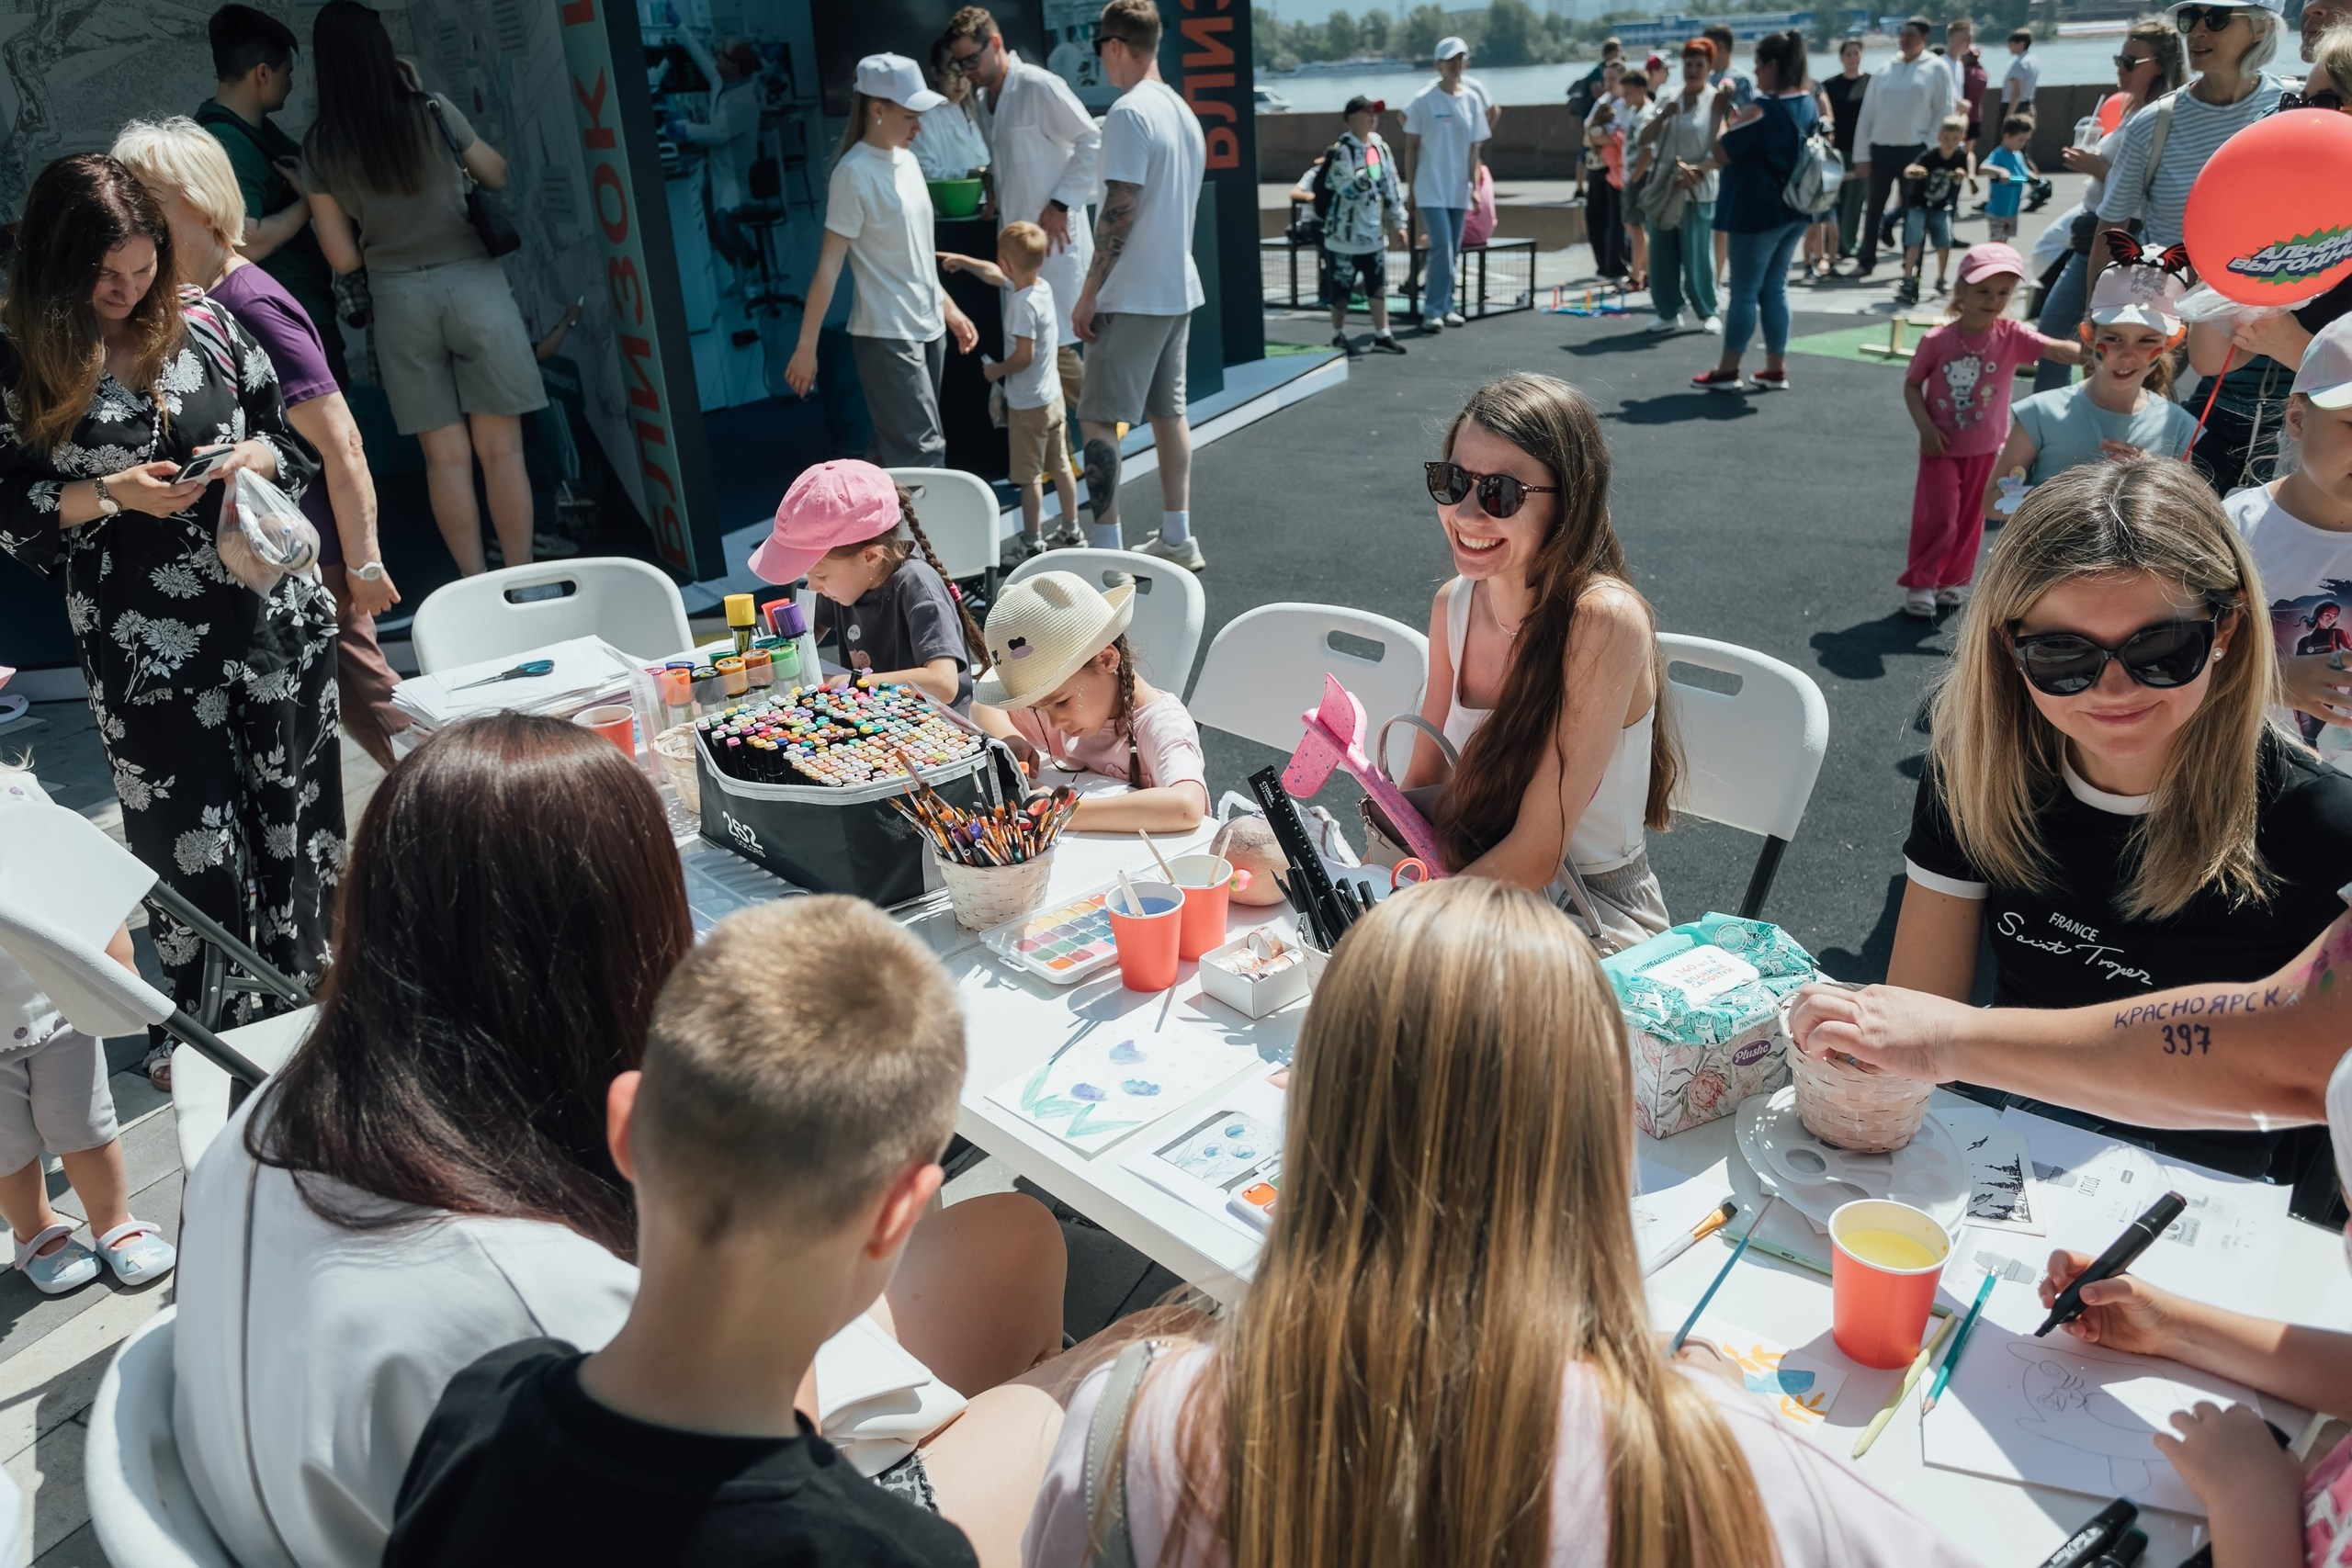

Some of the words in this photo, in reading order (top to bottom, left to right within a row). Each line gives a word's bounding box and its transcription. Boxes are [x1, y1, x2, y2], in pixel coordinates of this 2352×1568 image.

[573, 67, 690, 571] БЛИЗОК
[722, 811, 763, 850] 262
[734, 838, 766, 858] COLORS
[1997, 912, 2072, 954] Saint
[2049, 912, 2099, 942] FRANCE
[1634, 942, 1698, 974] АНТИБАКТЕРИАЛЬНЫЕ
[1679, 964, 1697, 976] 140
[1683, 963, 1726, 985] ВЛАЖНЫЕ
[1691, 966, 1735, 988] САЛФЕТКИ
[2114, 987, 2280, 1029] КРАСНОЯРСК
[1736, 1043, 1770, 1063] Plushe
[2162, 1024, 2211, 1055] 397
